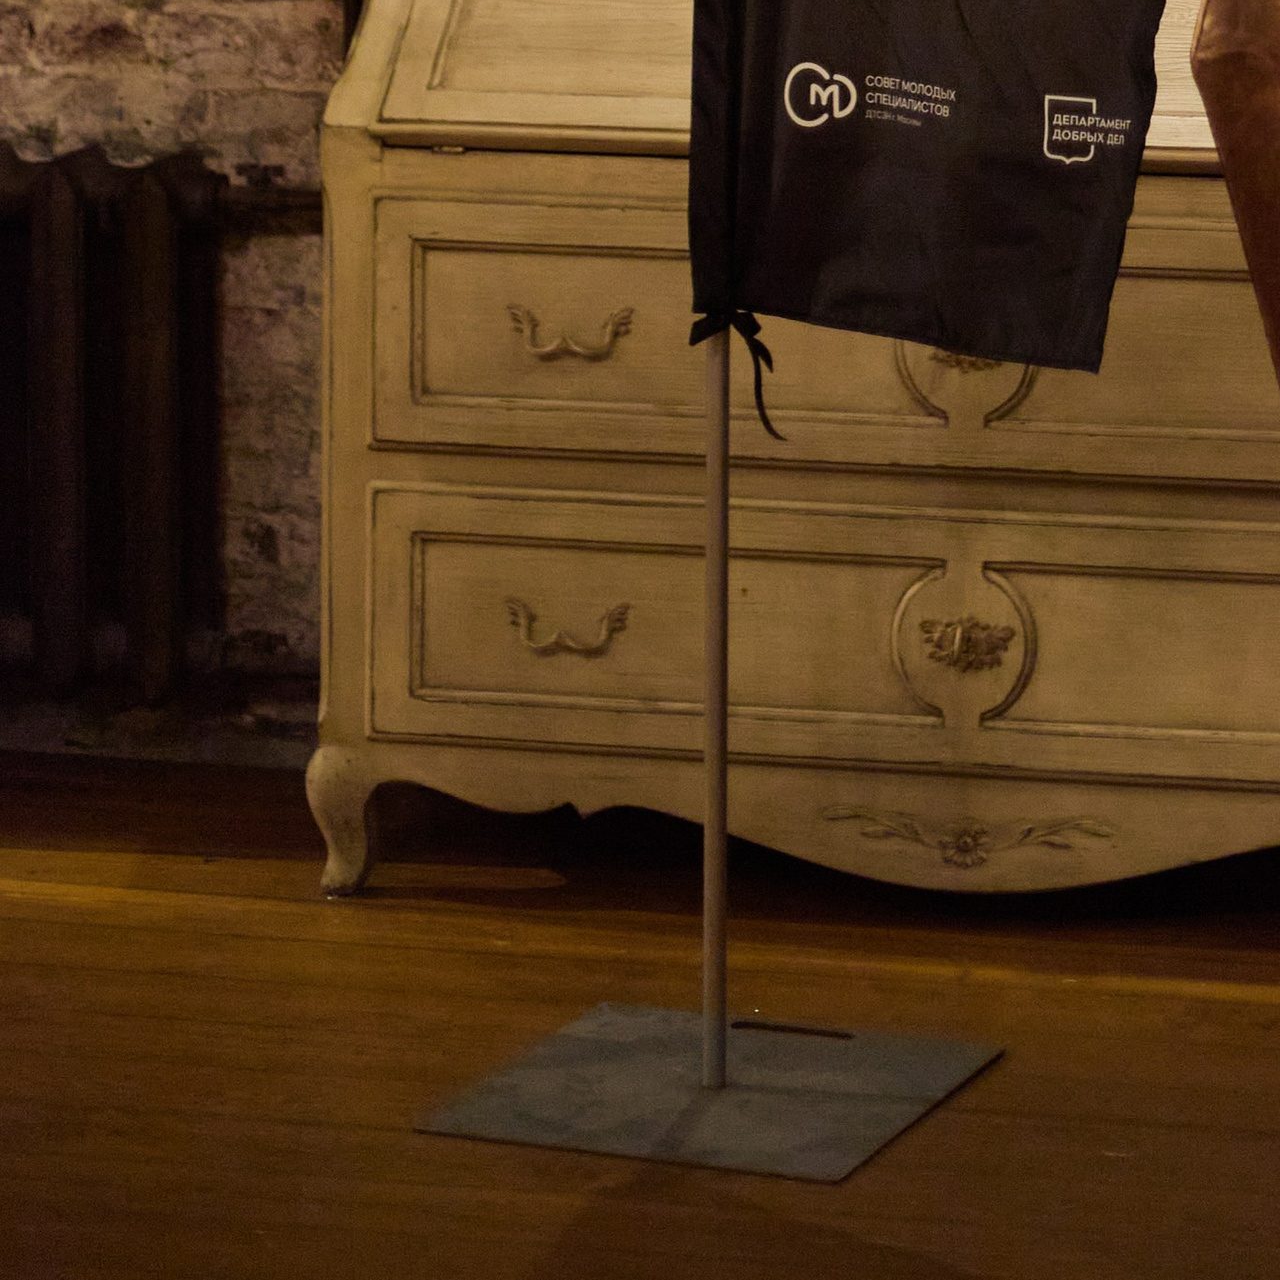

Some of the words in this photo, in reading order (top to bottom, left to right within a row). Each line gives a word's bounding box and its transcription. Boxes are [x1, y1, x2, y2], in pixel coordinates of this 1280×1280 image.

[865, 75, 900, 90] СОВЕТ
[901, 79, 957, 102] МОЛОДЫХ
[865, 92, 950, 117] СПЕЦИАЛИСТОВ
[1053, 114, 1131, 130] ДЕПАРТАМЕНТ
[1053, 129, 1104, 143] ДОБРЫХ
[1107, 134, 1124, 145] ДЕЛ
